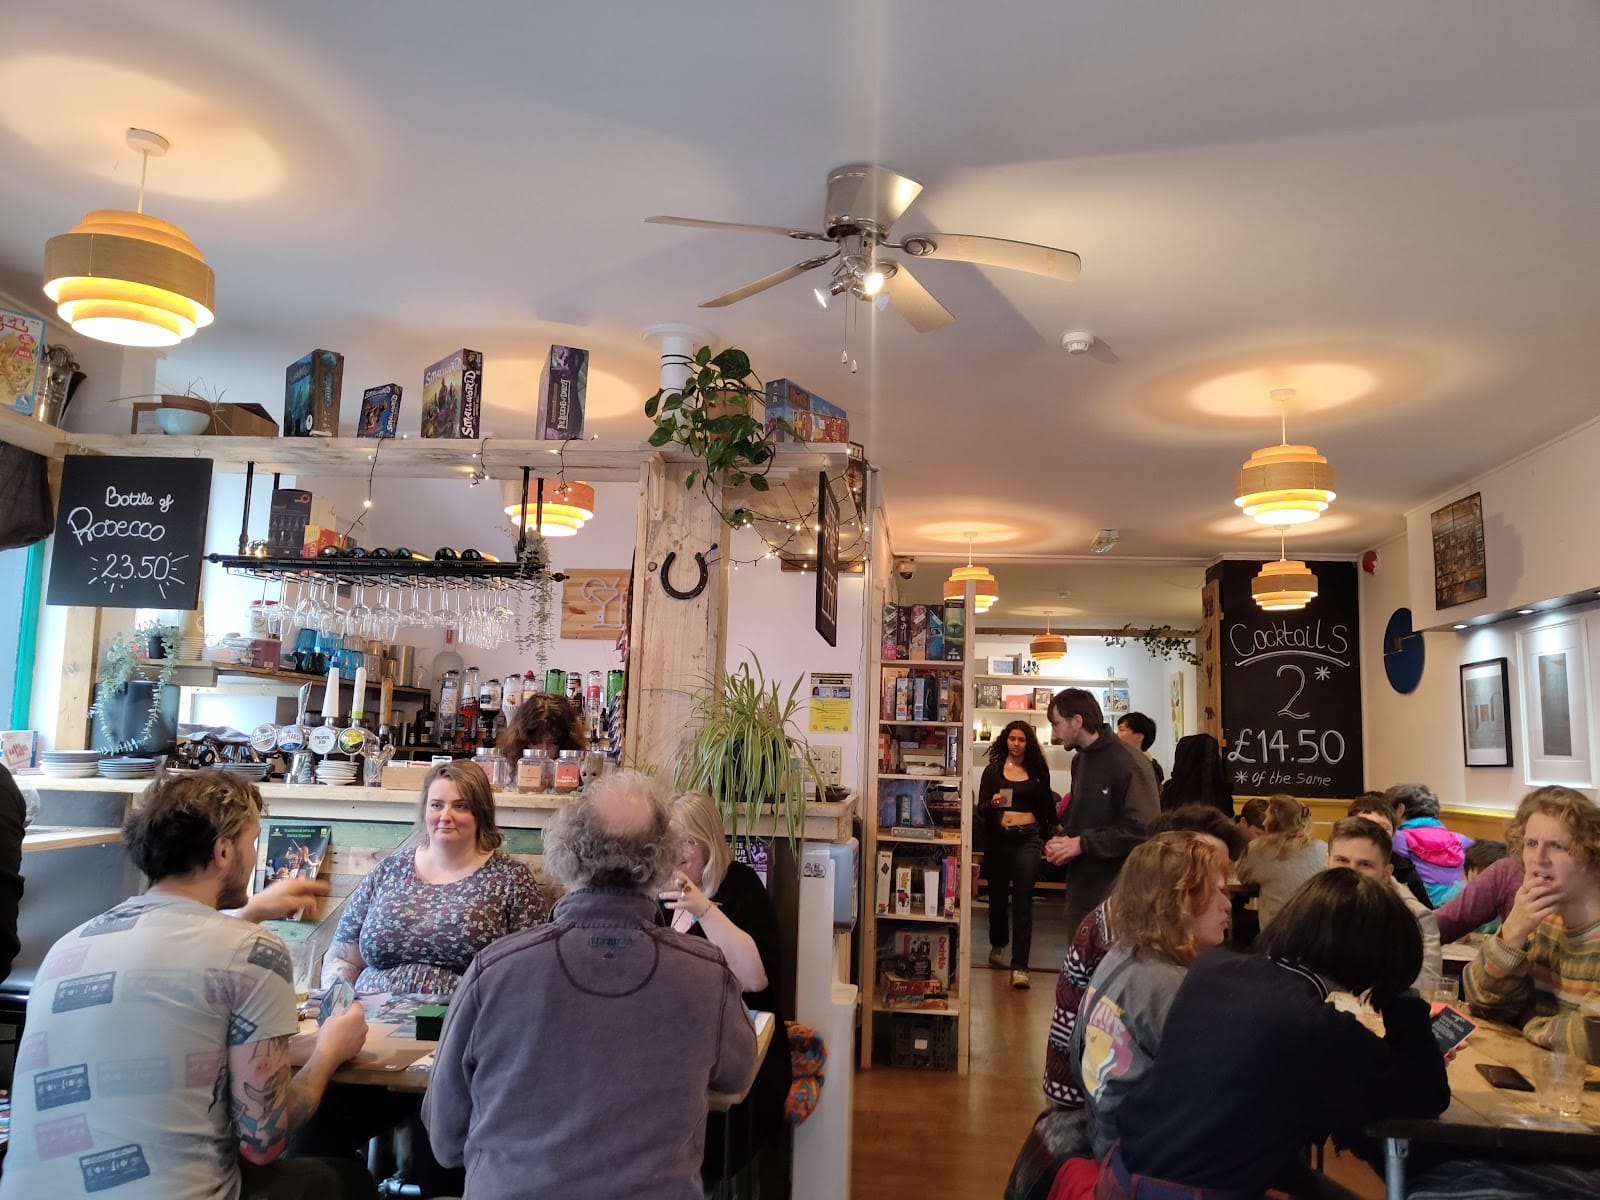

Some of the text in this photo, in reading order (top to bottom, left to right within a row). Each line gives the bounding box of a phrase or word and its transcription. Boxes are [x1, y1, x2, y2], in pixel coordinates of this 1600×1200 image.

[105, 486, 174, 513] Bottle of
[101, 553, 169, 580] 23.50
[1227, 728, 1345, 764] £14.50
[1269, 770, 1291, 785] the
